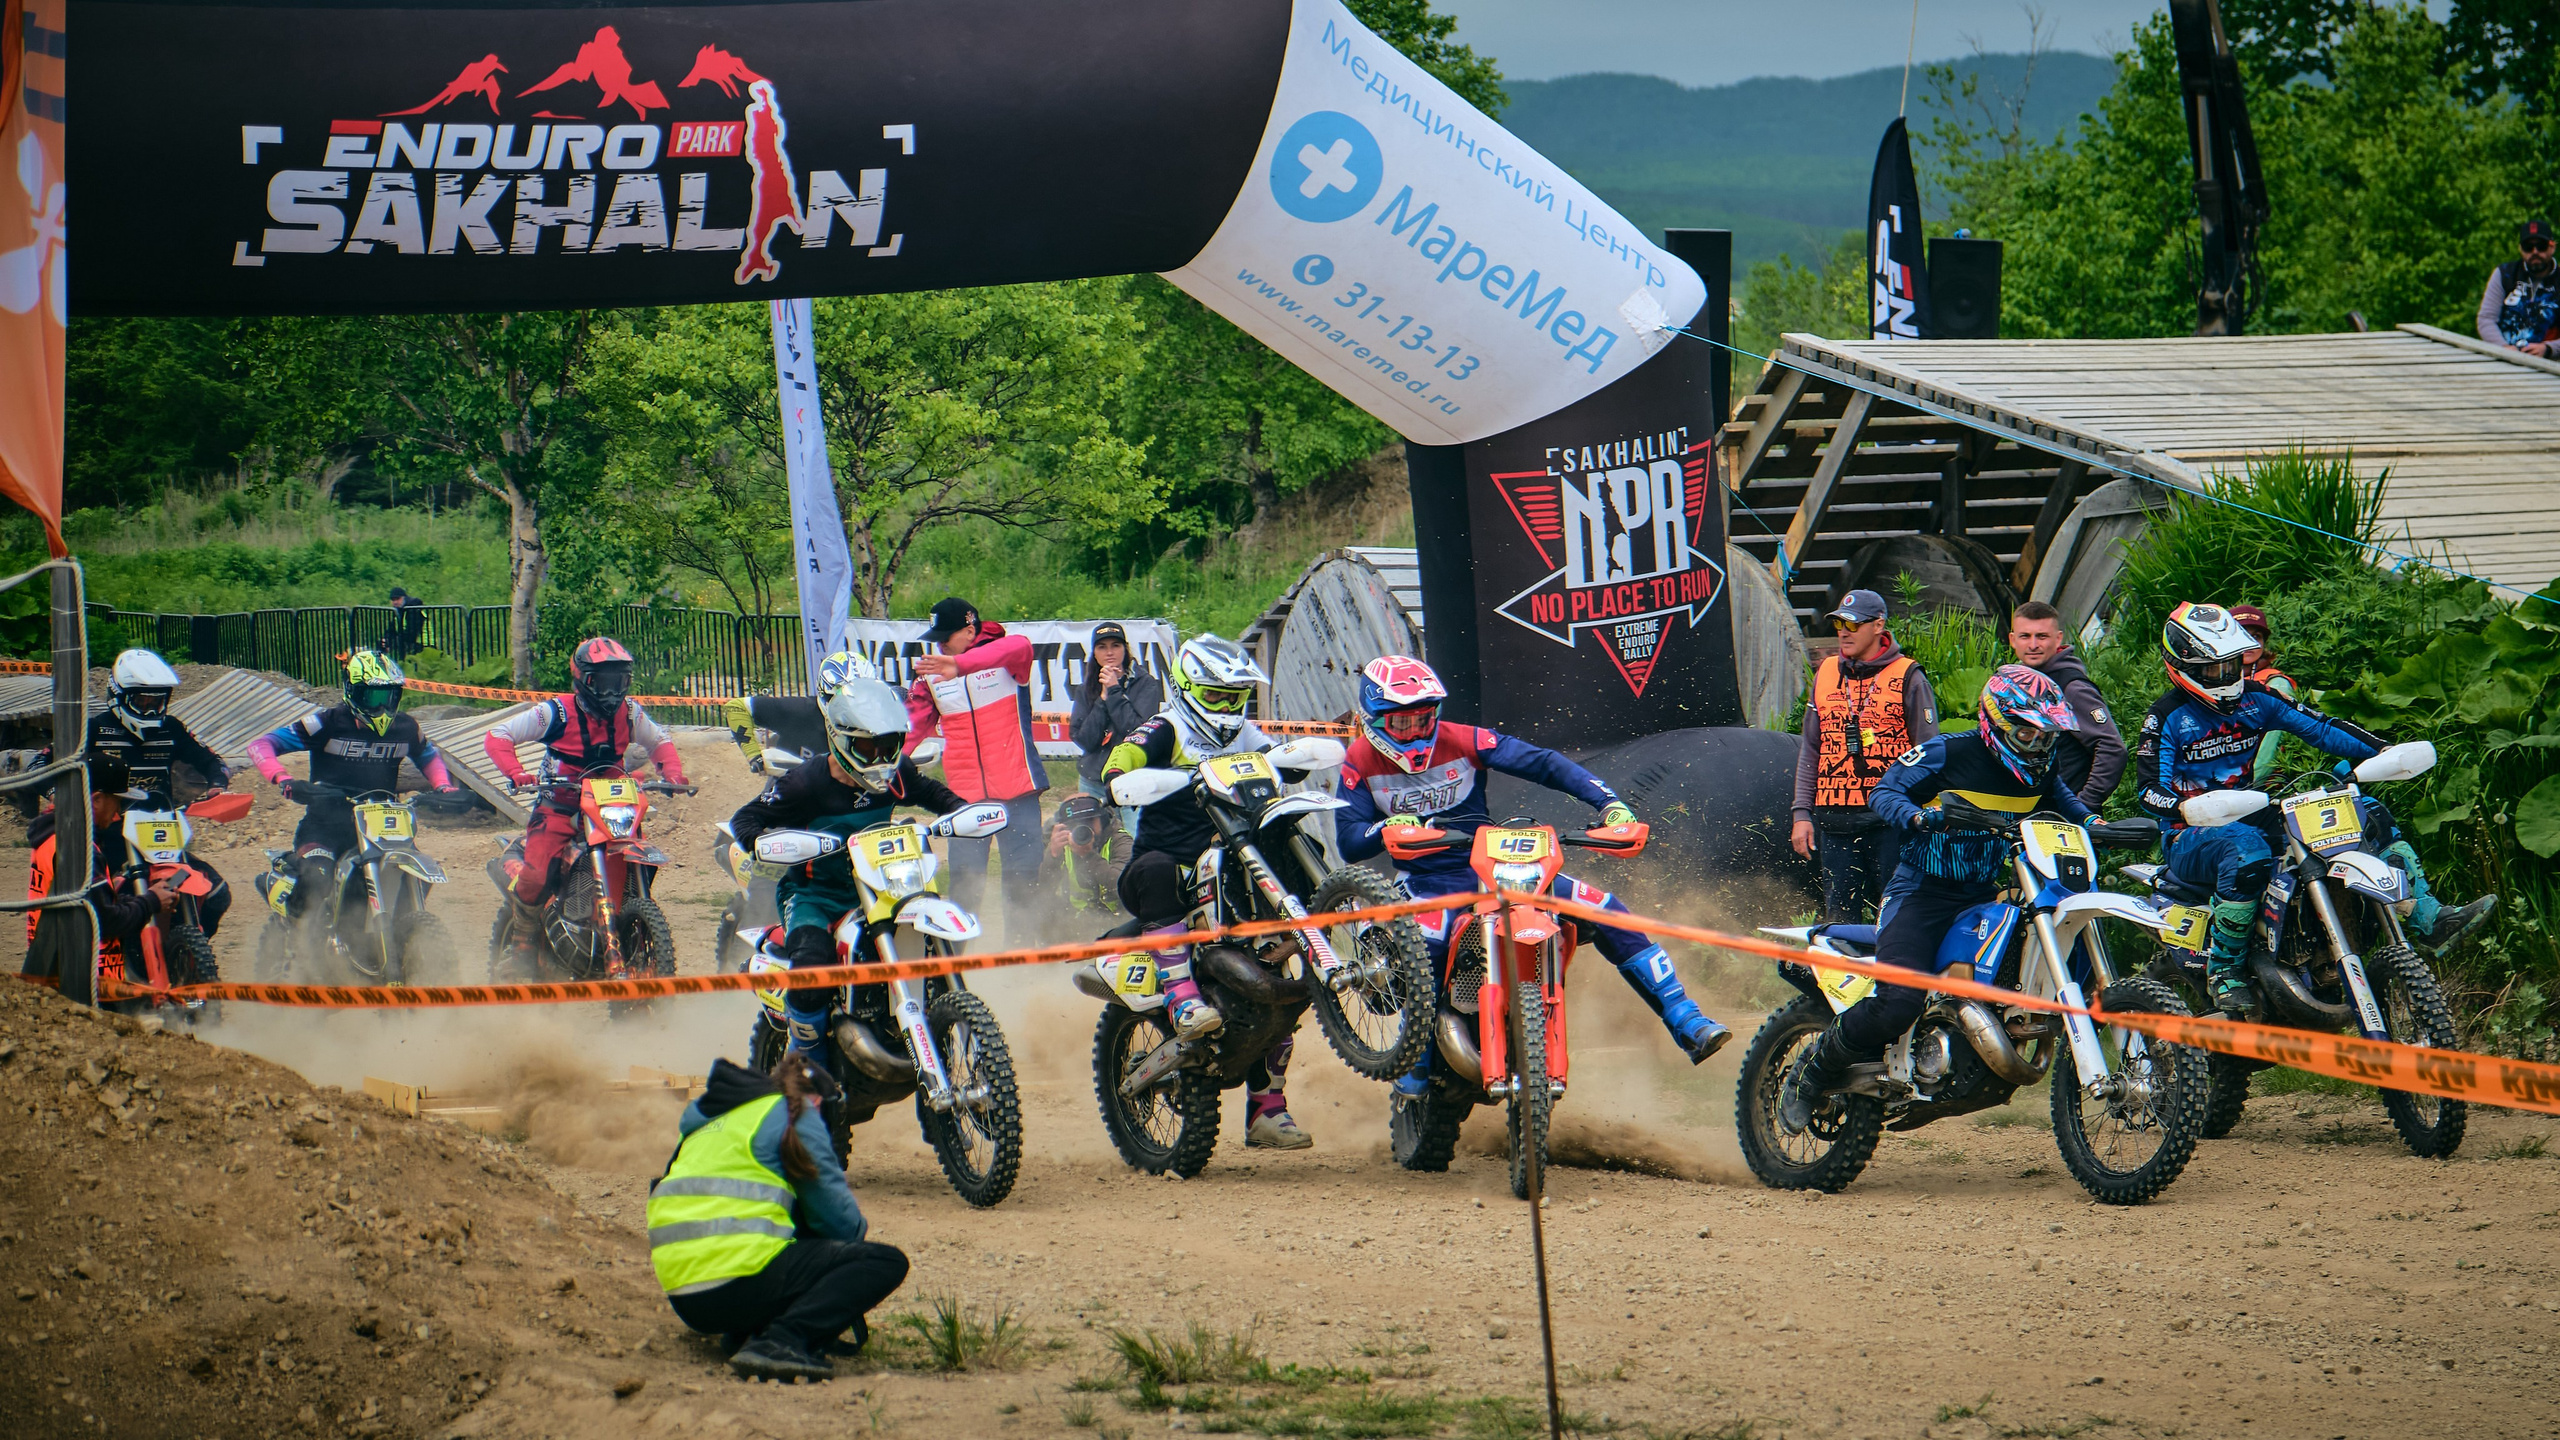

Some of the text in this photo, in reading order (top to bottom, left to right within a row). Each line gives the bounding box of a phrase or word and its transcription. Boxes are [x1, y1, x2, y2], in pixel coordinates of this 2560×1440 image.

[323, 120, 736, 170] ENDURO PARK
[1322, 18, 1667, 289] Медицинский Центр
[1374, 184, 1619, 375] МареМед
[1873, 219, 1891, 340] SA
[1888, 259, 1920, 340] EN
[1334, 281, 1482, 383] 31-13-13
[1236, 266, 1462, 417] www.maremed.ru
[1562, 430, 1680, 473] SAKHALIN
[1560, 459, 1691, 589] NPR
[1531, 568, 1712, 624] NO PLACE TO RUN
[1614, 619, 1660, 638] EXTREME
[1618, 633, 1657, 650] ENDURO
[1623, 645, 1654, 661] RALLY
[610, 785, 623, 796] 5
[1390, 778, 1464, 814] LEATT
[2317, 798, 2342, 808] GOLD
[384, 816, 397, 829] 9
[2320, 808, 2337, 830] 3
[154, 829, 167, 843] 2
[880, 828, 905, 838] GOLD
[2052, 824, 2073, 833] GOLD
[878, 838, 905, 855] 21
[1500, 838, 1536, 853] 46
[2057, 833, 2068, 847] 1
[2311, 832, 2361, 849] POLYMERIUM
[2185, 909, 2203, 919] GOLD
[2175, 918, 2195, 937] 3
[1125, 965, 1147, 983] 13
[1839, 974, 1857, 989] 1
[915, 1023, 936, 1069] OSSPORT
